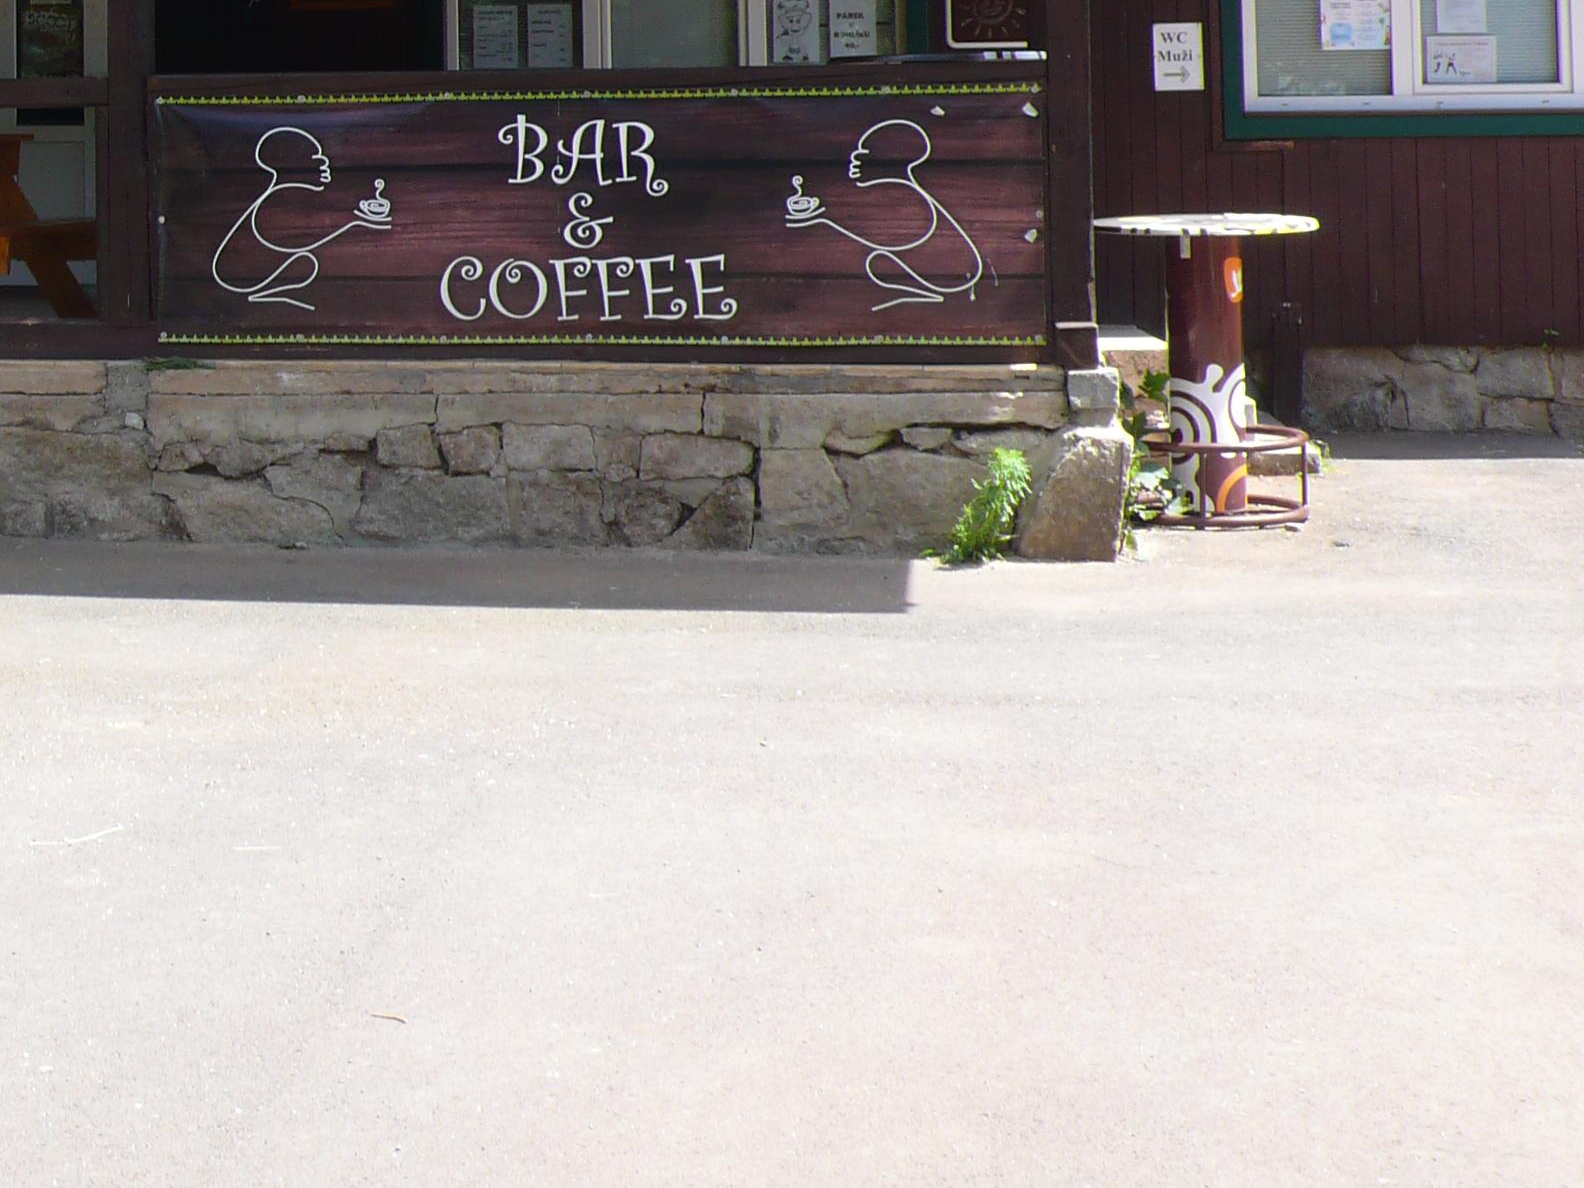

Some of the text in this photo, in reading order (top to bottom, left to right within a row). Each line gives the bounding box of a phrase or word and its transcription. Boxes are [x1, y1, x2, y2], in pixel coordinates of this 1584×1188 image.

[1158, 48, 1193, 62] Muži
[1160, 31, 1189, 44] WC
[497, 114, 670, 197] BAR
[563, 192, 614, 249] &
[440, 254, 738, 322] COFFEE
